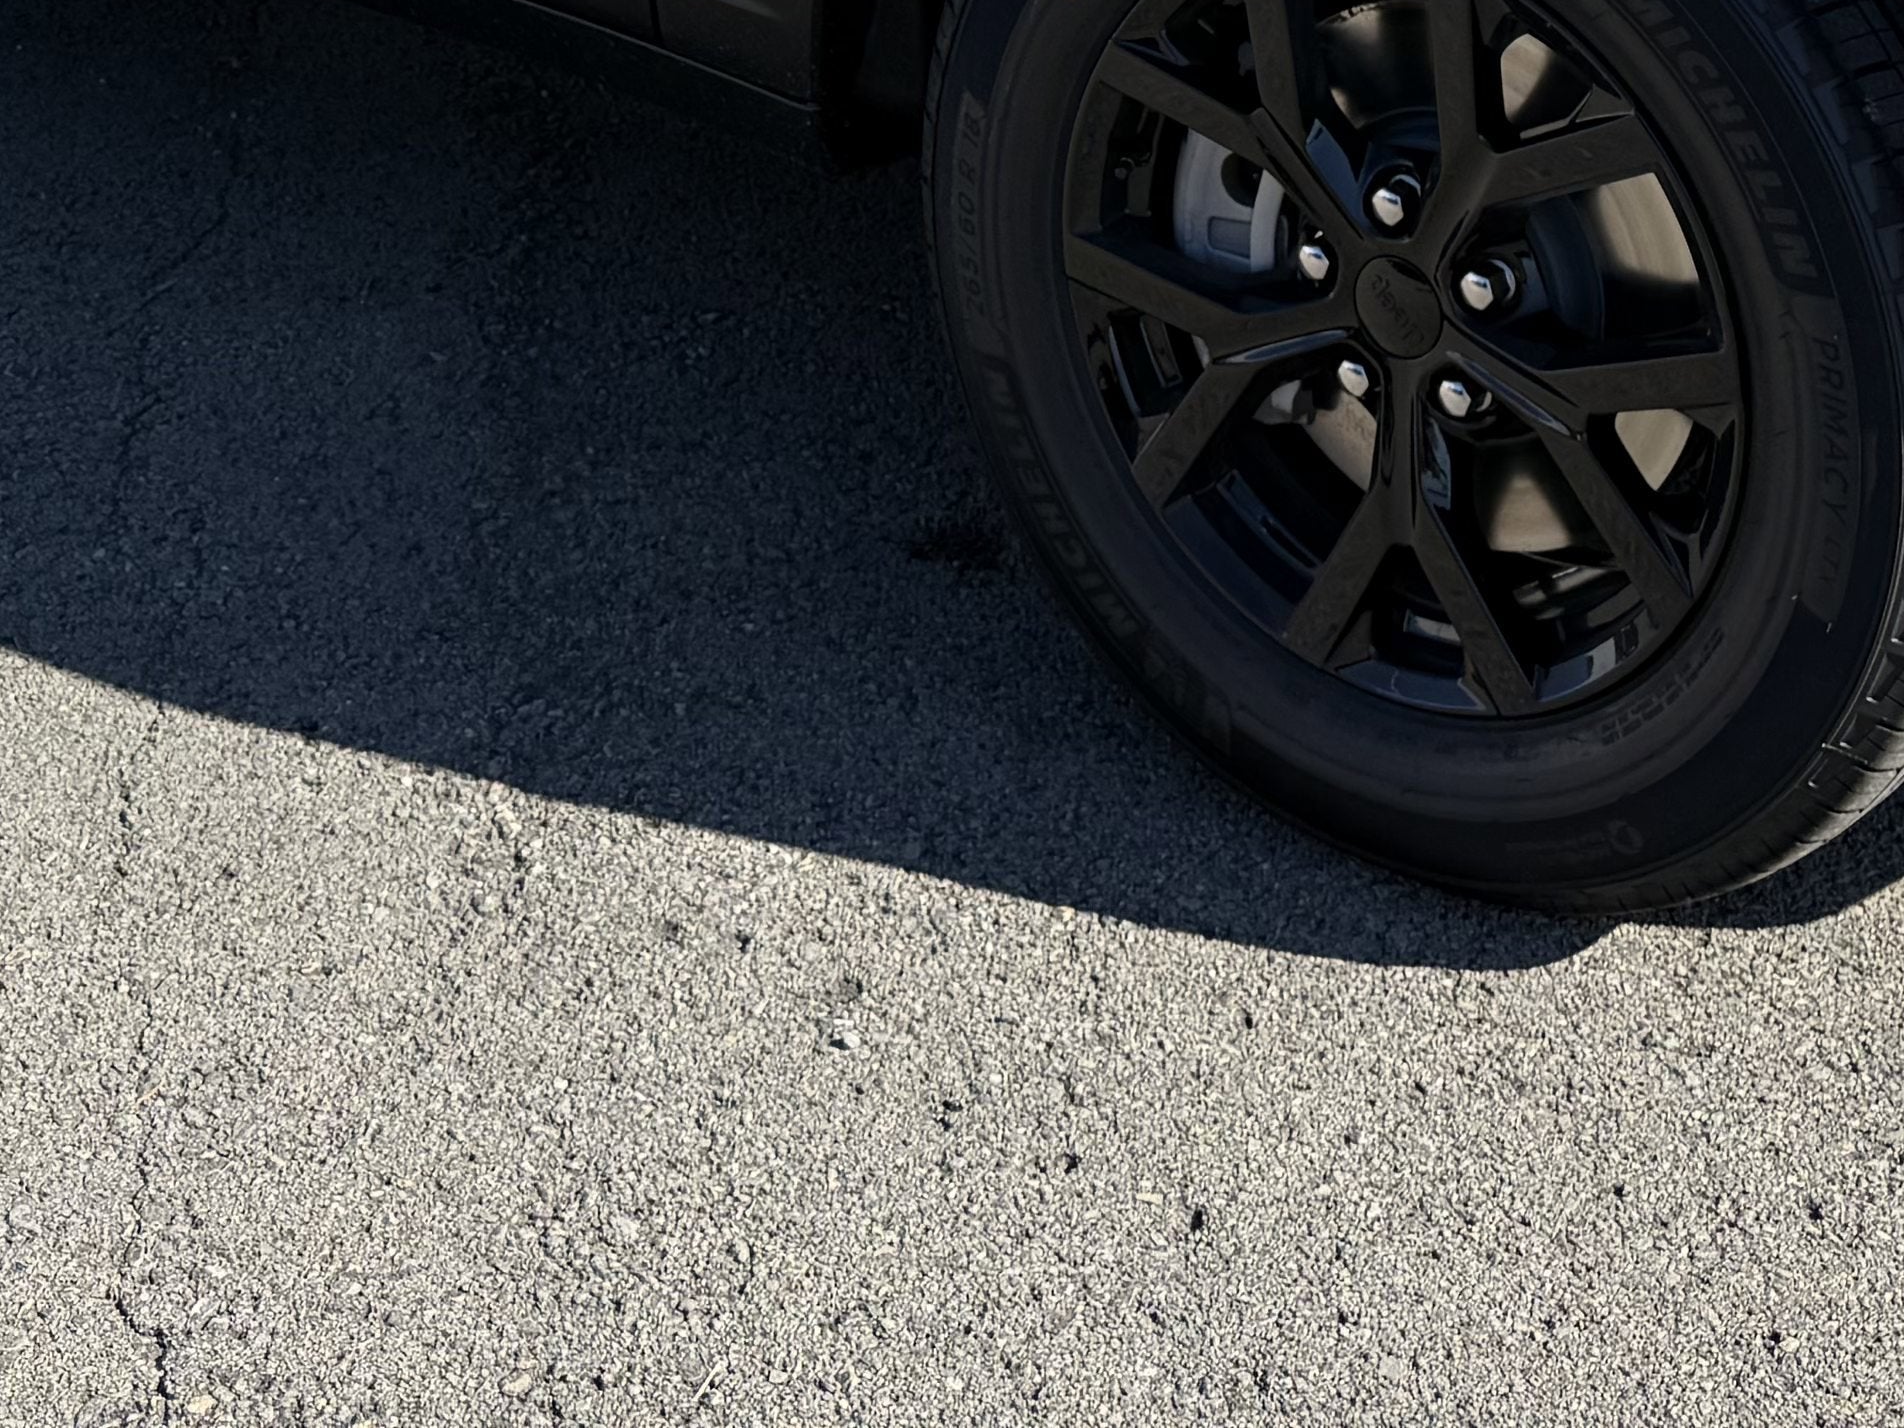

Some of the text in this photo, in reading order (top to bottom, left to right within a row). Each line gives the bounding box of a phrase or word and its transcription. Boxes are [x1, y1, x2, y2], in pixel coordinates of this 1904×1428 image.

[957, 111, 986, 316] 265/60 R 18
[981, 364, 1140, 637] MICHELIN
[1811, 335, 1848, 526] PRIMACY
